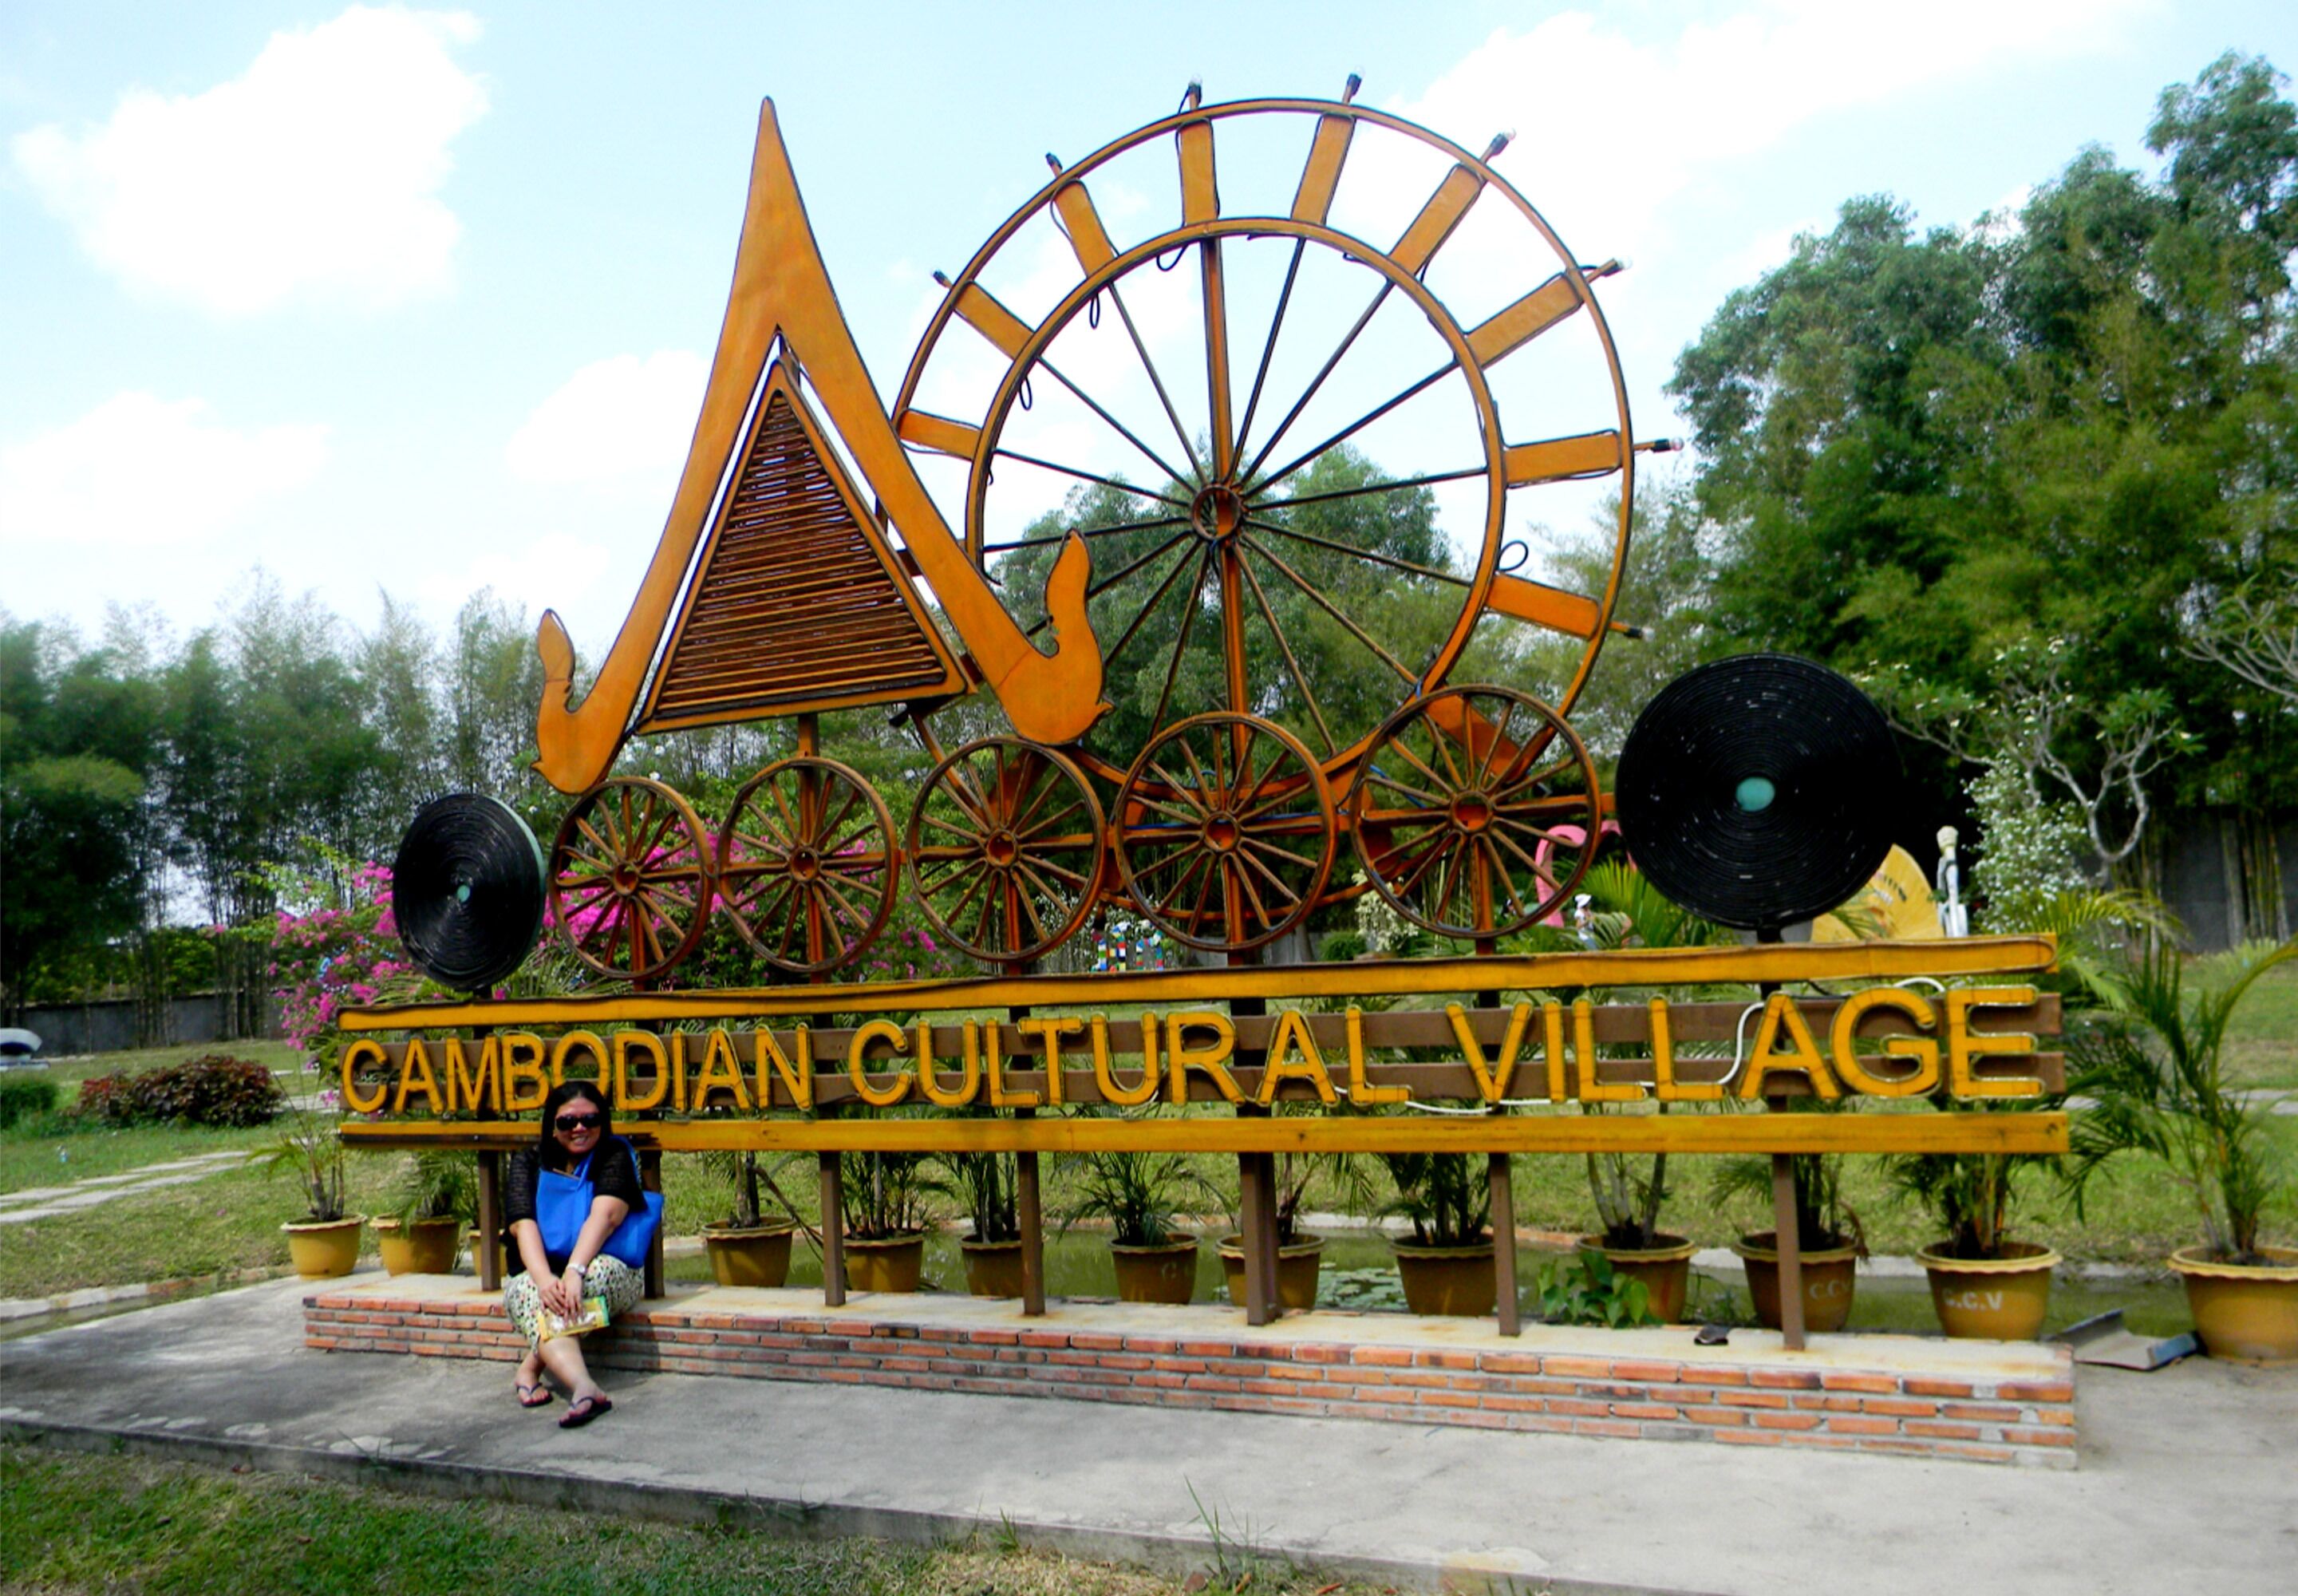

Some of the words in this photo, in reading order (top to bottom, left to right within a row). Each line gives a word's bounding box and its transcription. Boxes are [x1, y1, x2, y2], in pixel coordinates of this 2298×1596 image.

[342, 1023, 811, 1113] CAMBODIAN
[849, 1005, 1412, 1107] CULTURAL
[1446, 984, 2046, 1103] VILLAGE
